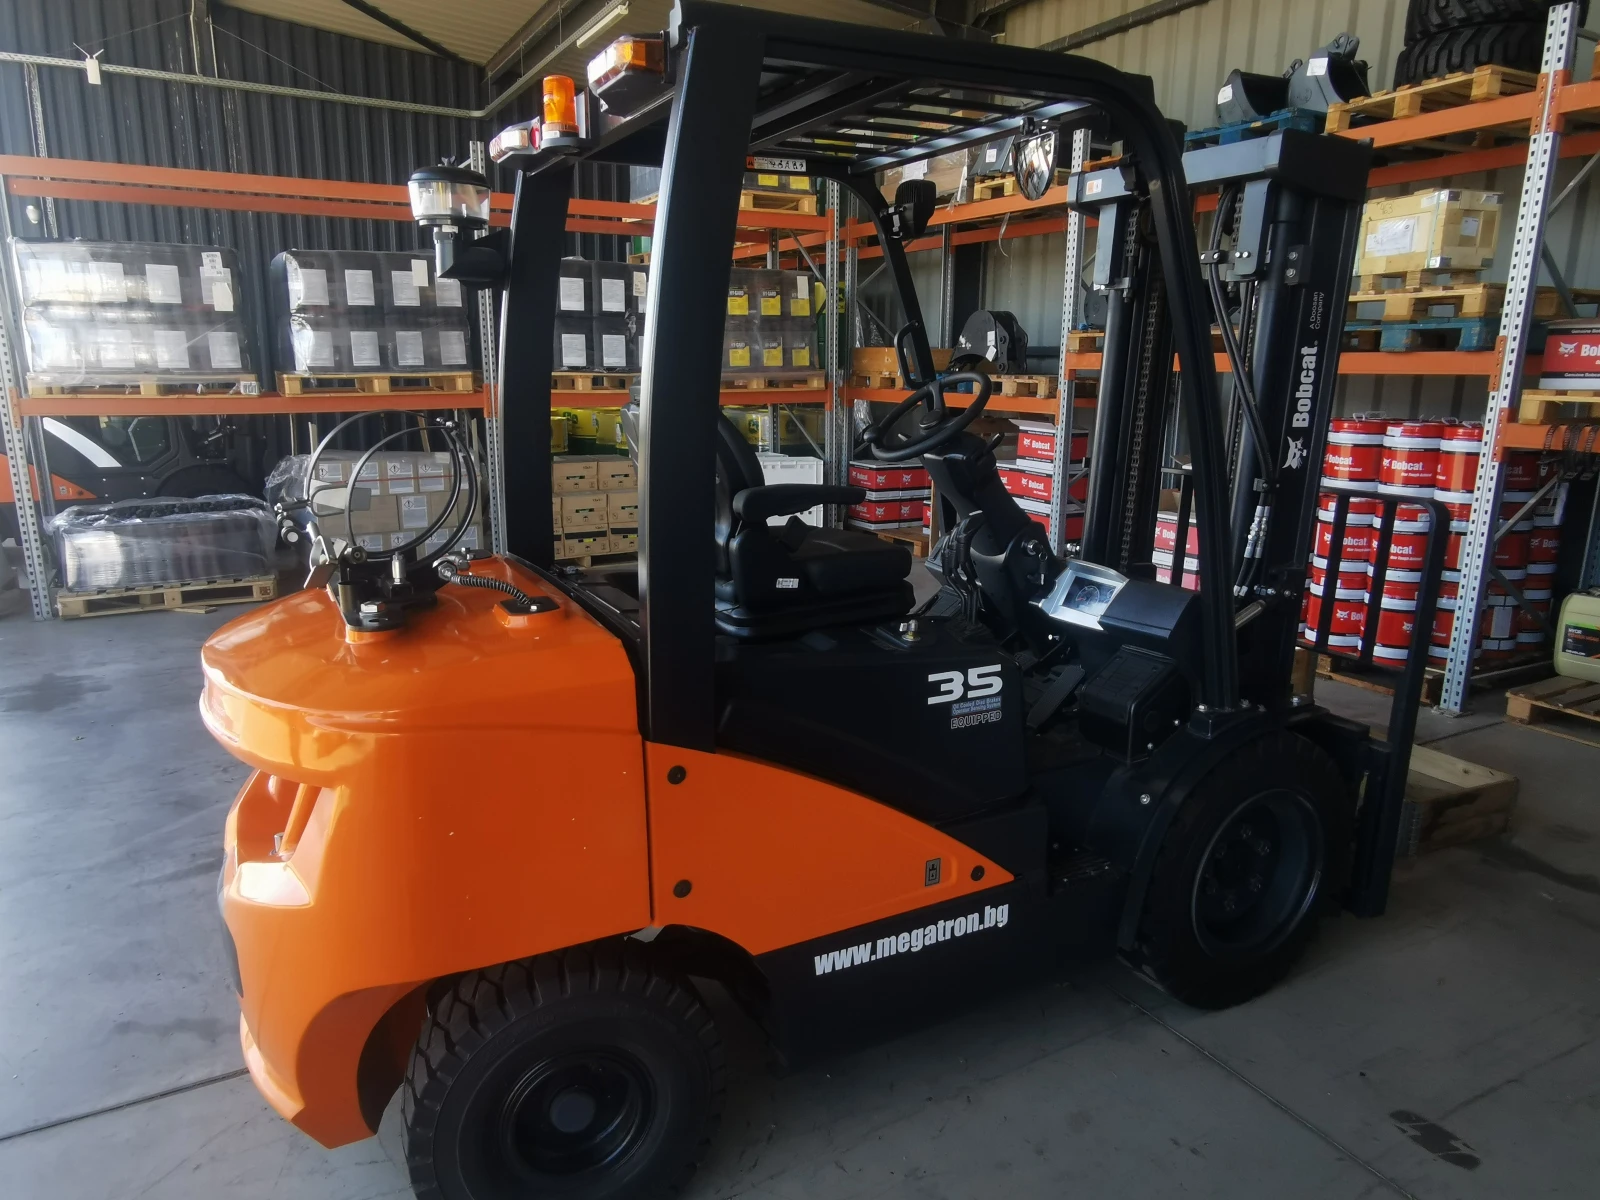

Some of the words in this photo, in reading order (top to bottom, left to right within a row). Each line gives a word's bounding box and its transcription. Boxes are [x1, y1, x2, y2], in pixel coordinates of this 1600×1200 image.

[1309, 291, 1319, 322] Doosan
[1314, 291, 1325, 330] Company
[1291, 346, 1318, 428] Bobcat
[1031, 440, 1051, 450] Bobcat
[1391, 460, 1423, 471] Bobcat
[1162, 529, 1176, 540] Bob
[1342, 536, 1367, 547] obcat
[1390, 543, 1413, 555] bcat
[928, 664, 1003, 705] 35
[950, 710, 1002, 729] EQUIPPED
[814, 904, 1009, 976] www.megatron.bg
